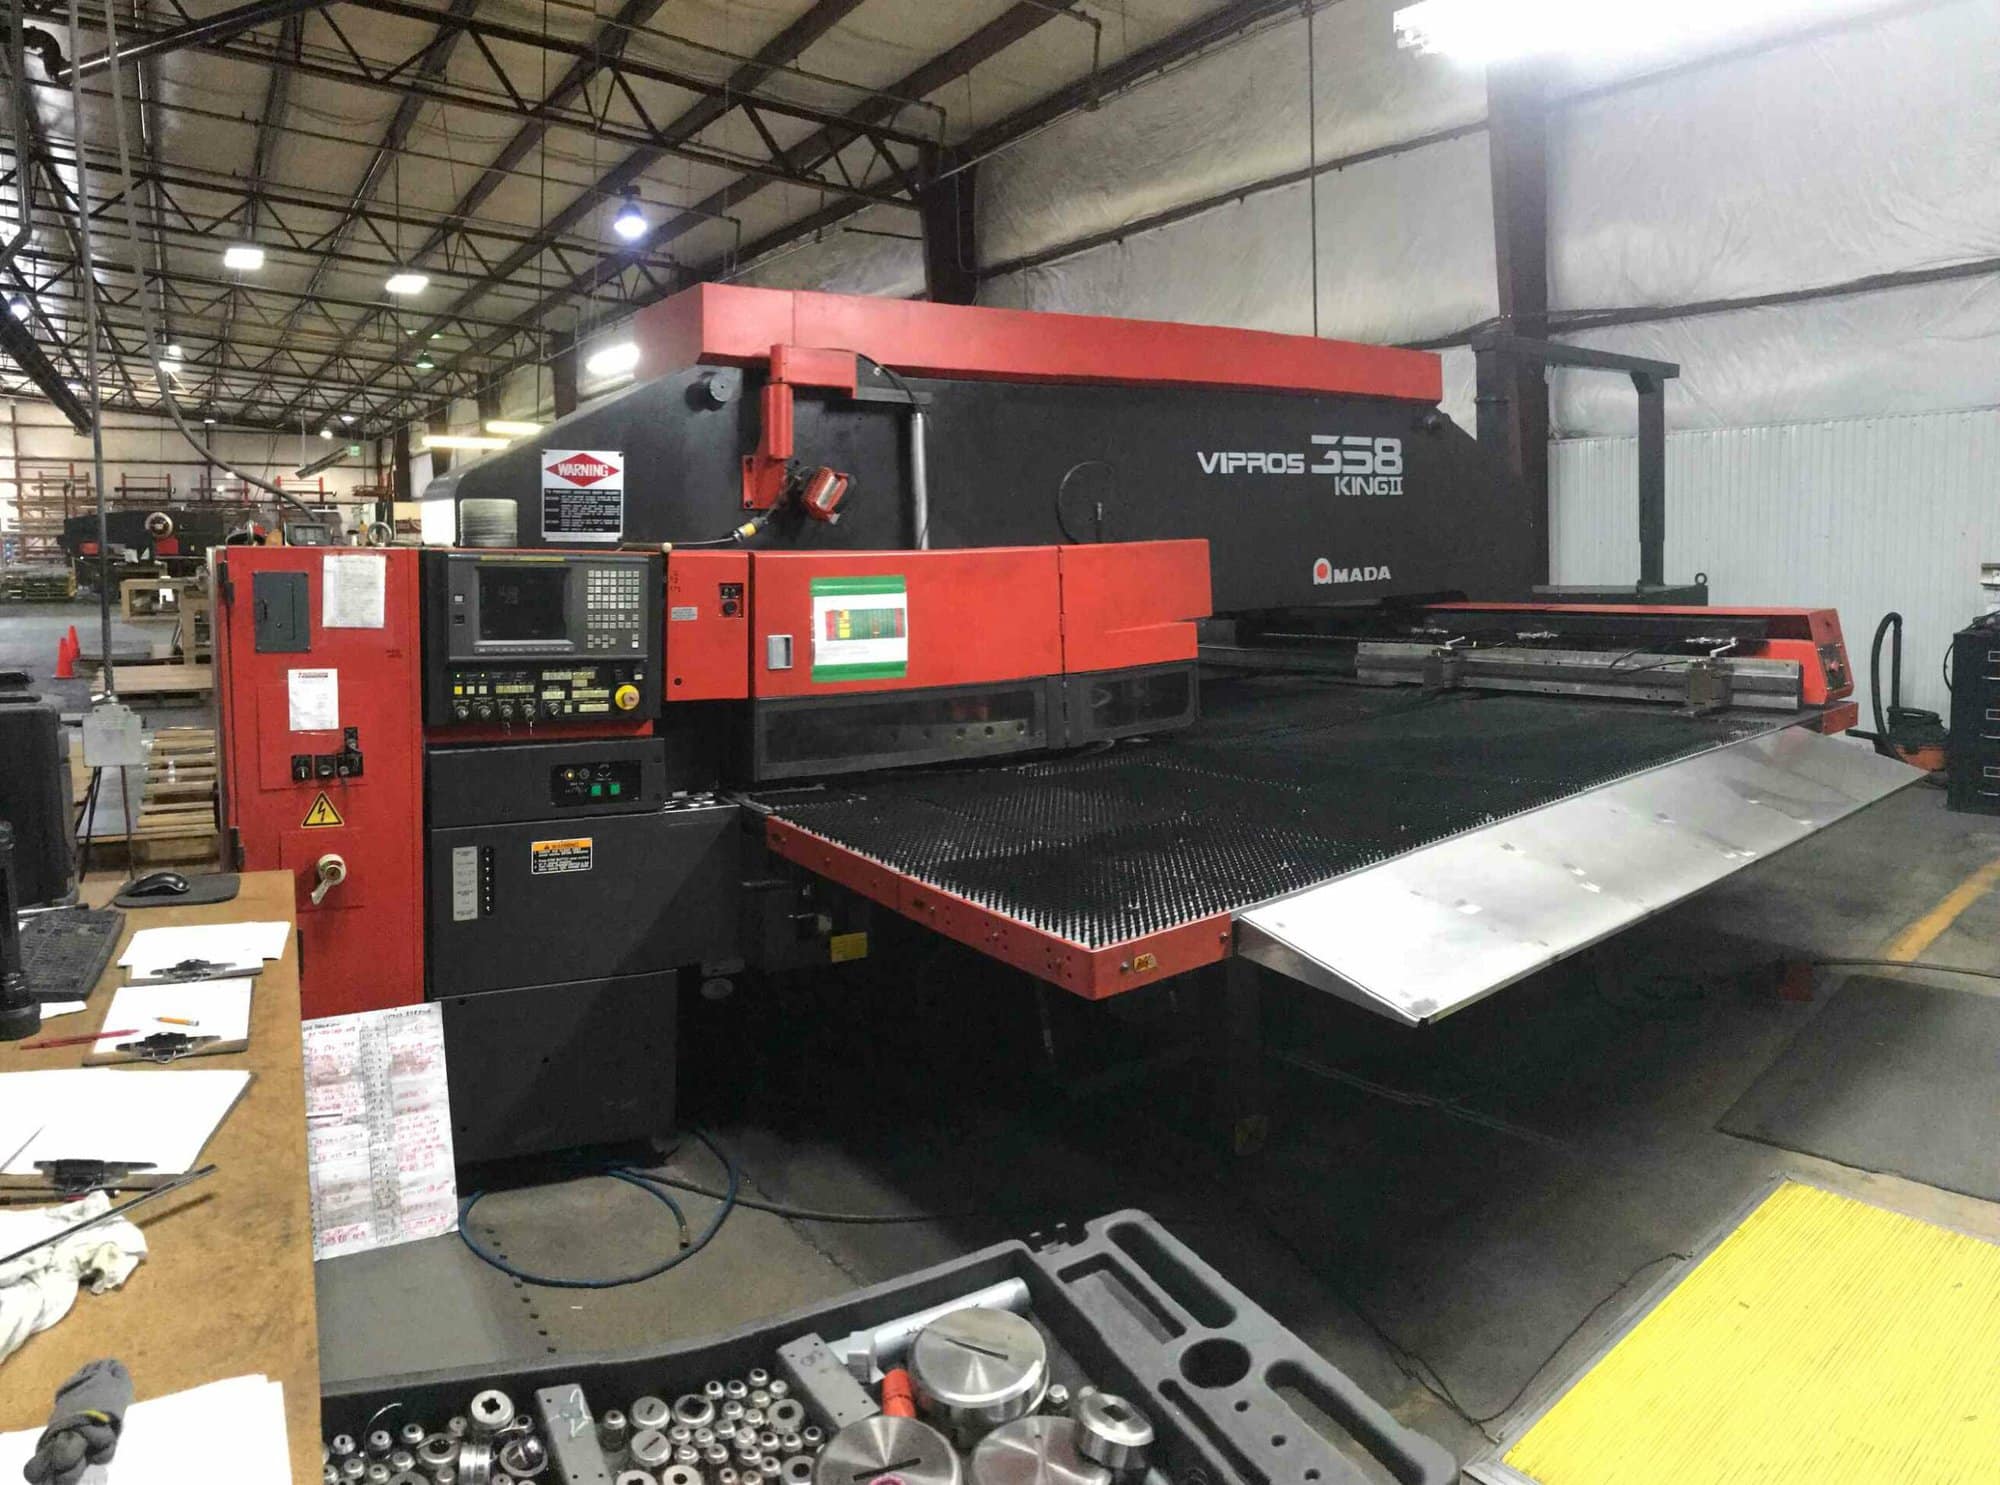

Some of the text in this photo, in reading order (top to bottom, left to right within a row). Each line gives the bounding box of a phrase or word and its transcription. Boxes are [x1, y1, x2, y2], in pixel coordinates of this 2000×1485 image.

[1197, 434, 1403, 474] VIPROS 358
[558, 463, 609, 477] WARNING
